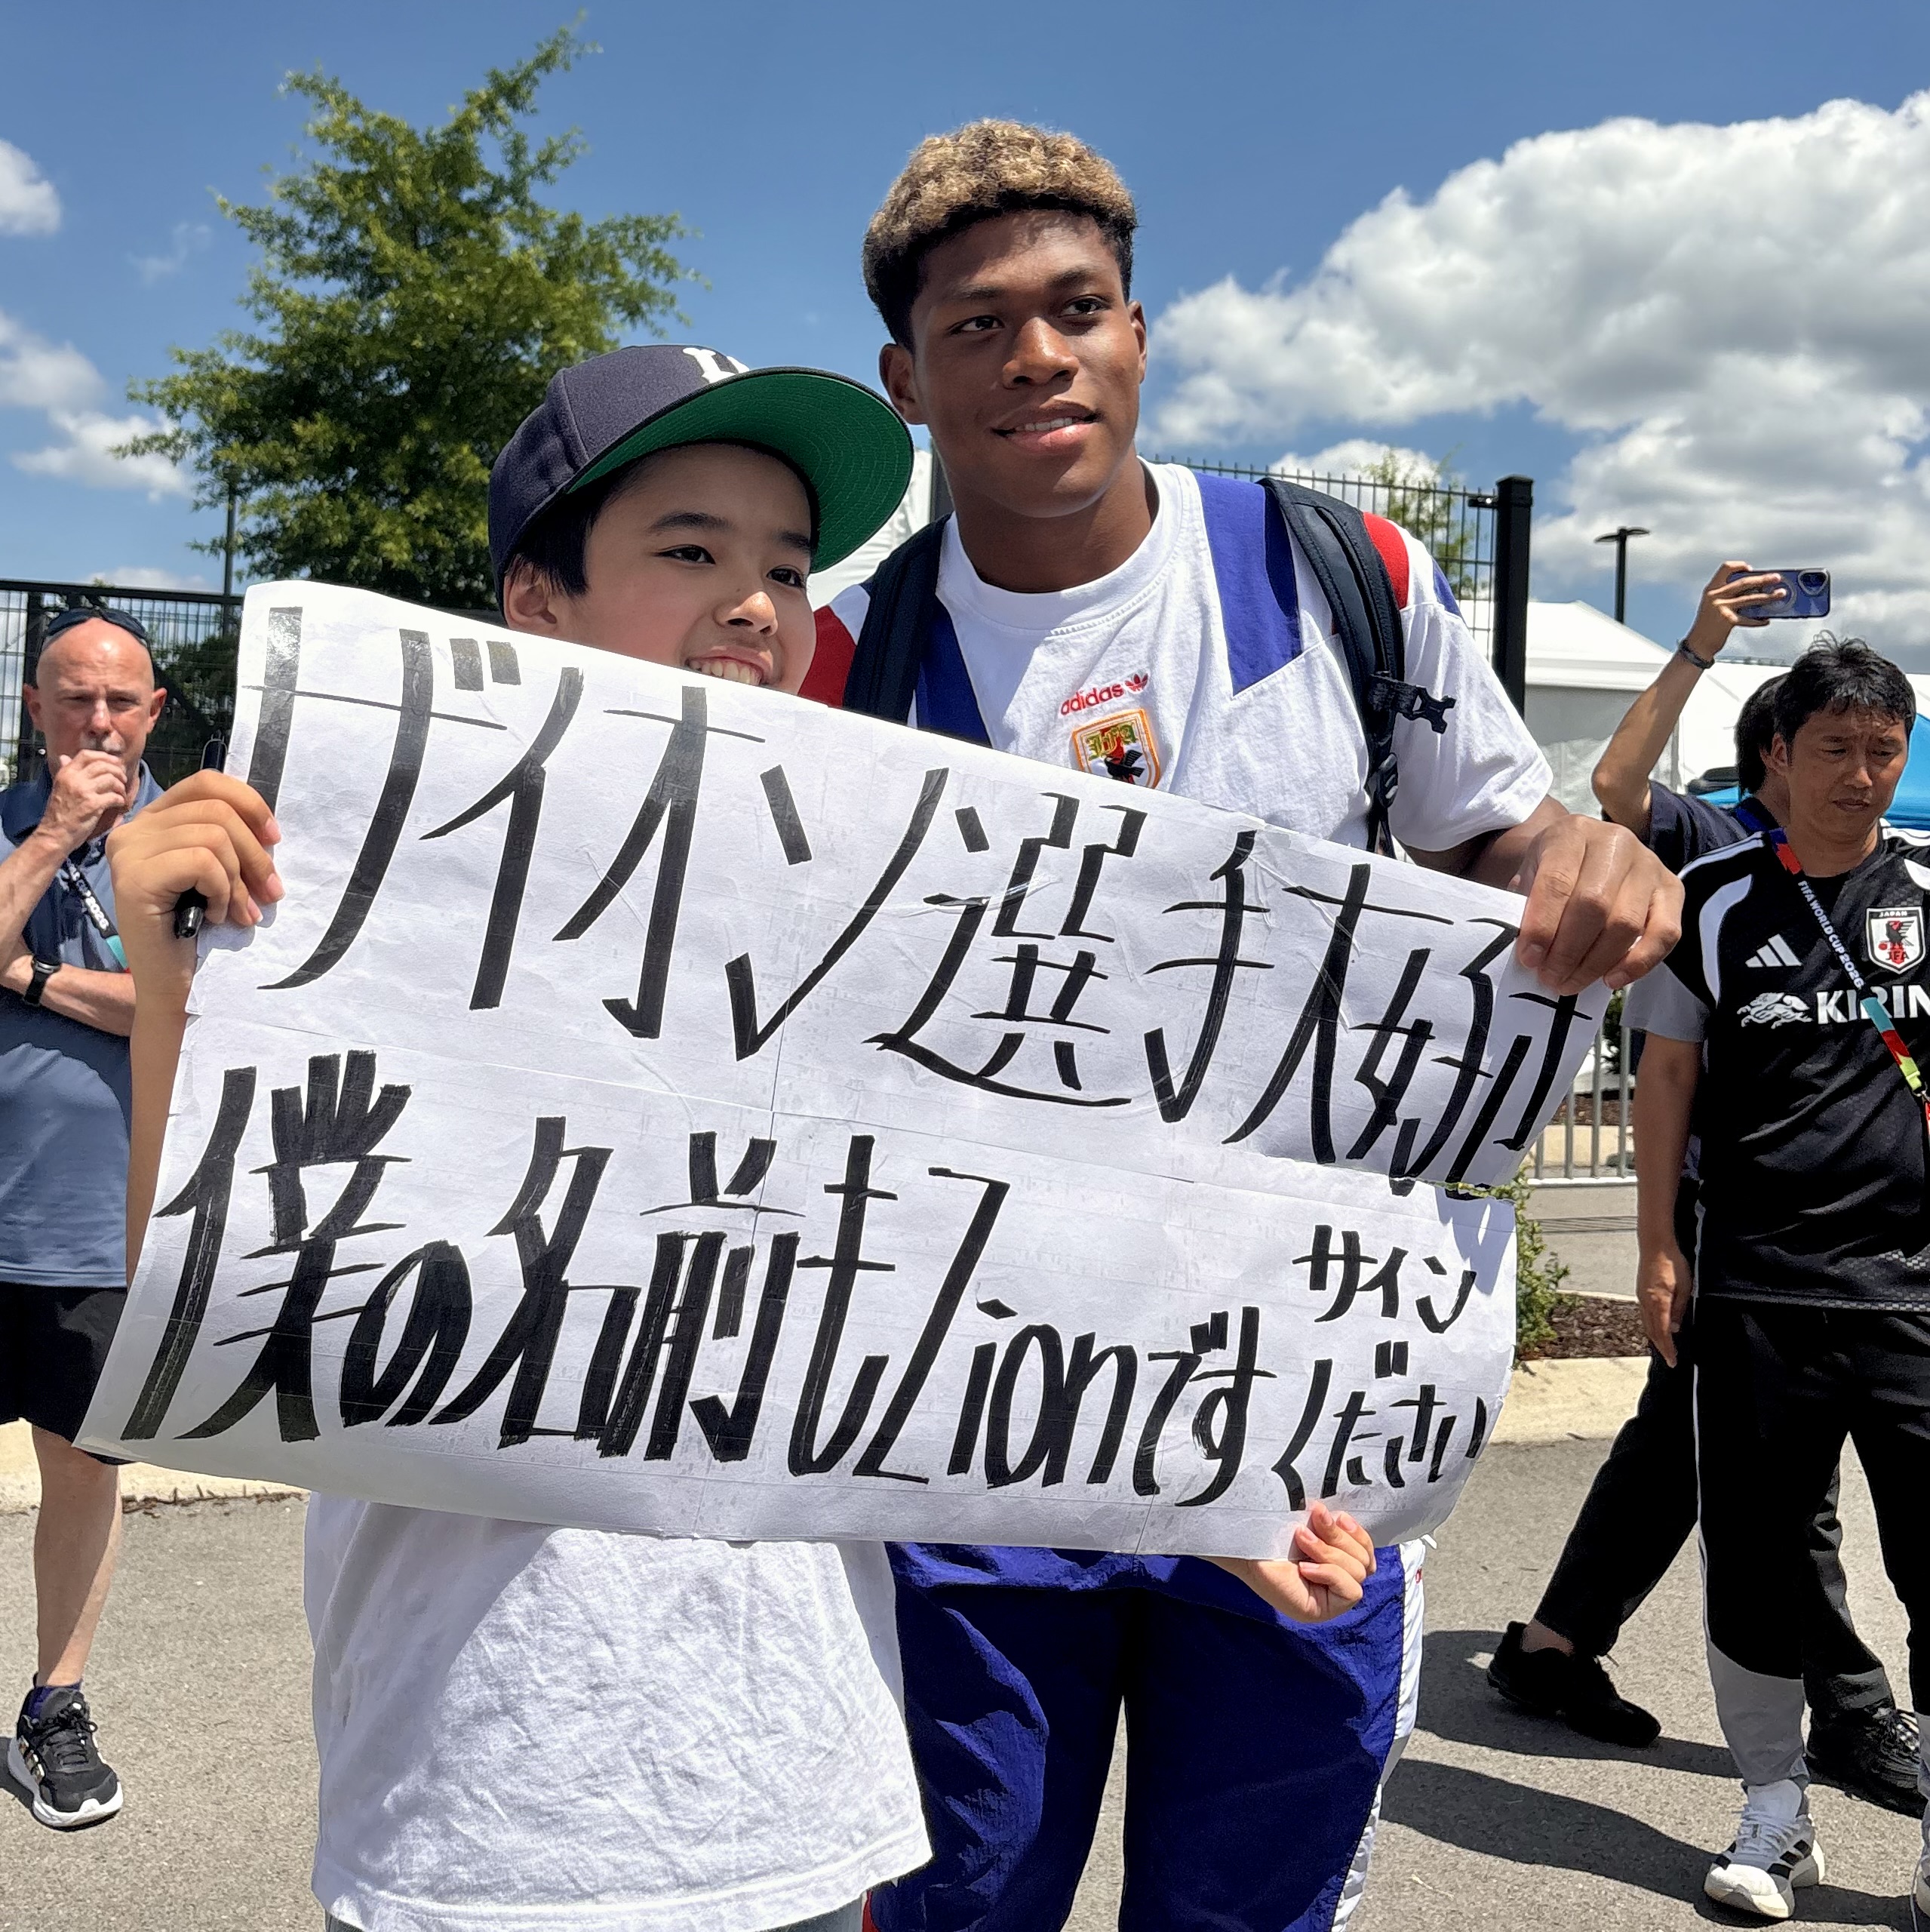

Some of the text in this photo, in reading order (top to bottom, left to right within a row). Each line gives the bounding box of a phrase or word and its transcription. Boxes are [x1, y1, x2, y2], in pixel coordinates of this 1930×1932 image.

[1060, 683, 1124, 715] adidas
[85, 896, 109, 931] 2026
[1879, 909, 1908, 918] JAPAN
[1797, 880, 1864, 989] FIFA WORLD CUP 2026
[1885, 950, 1910, 961] JFA
[1292, 1224, 1477, 1334] サイン
[1271, 1340, 1486, 1512] ください
